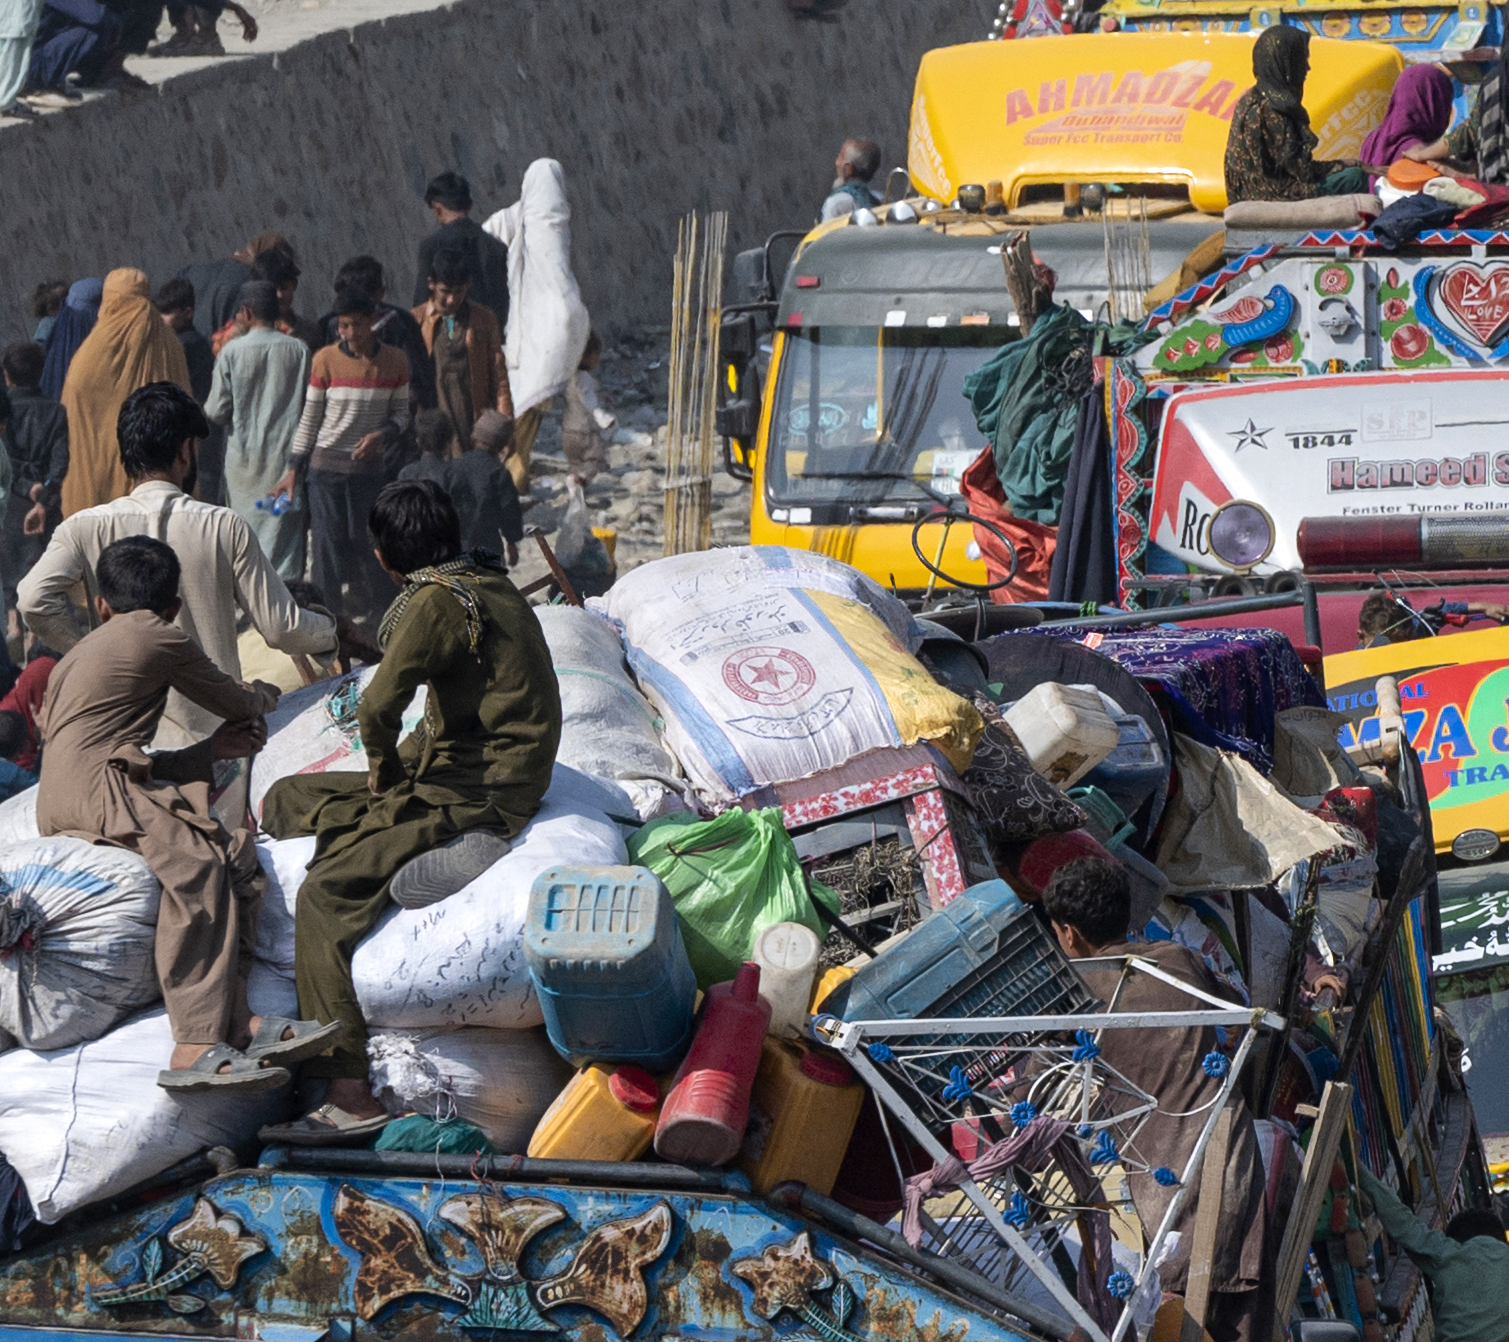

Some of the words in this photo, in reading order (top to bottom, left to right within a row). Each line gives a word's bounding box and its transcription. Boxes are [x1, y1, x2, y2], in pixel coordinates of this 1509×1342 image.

[1023, 133, 1062, 148] Super
[1093, 132, 1162, 146] Transport
[1290, 433, 1353, 450] 1844
[1328, 452, 1488, 493] Hameed
[1342, 504, 1402, 516] Fenster
[1407, 502, 1461, 514] Turner
[1326, 682, 1429, 714] ATIOAL
